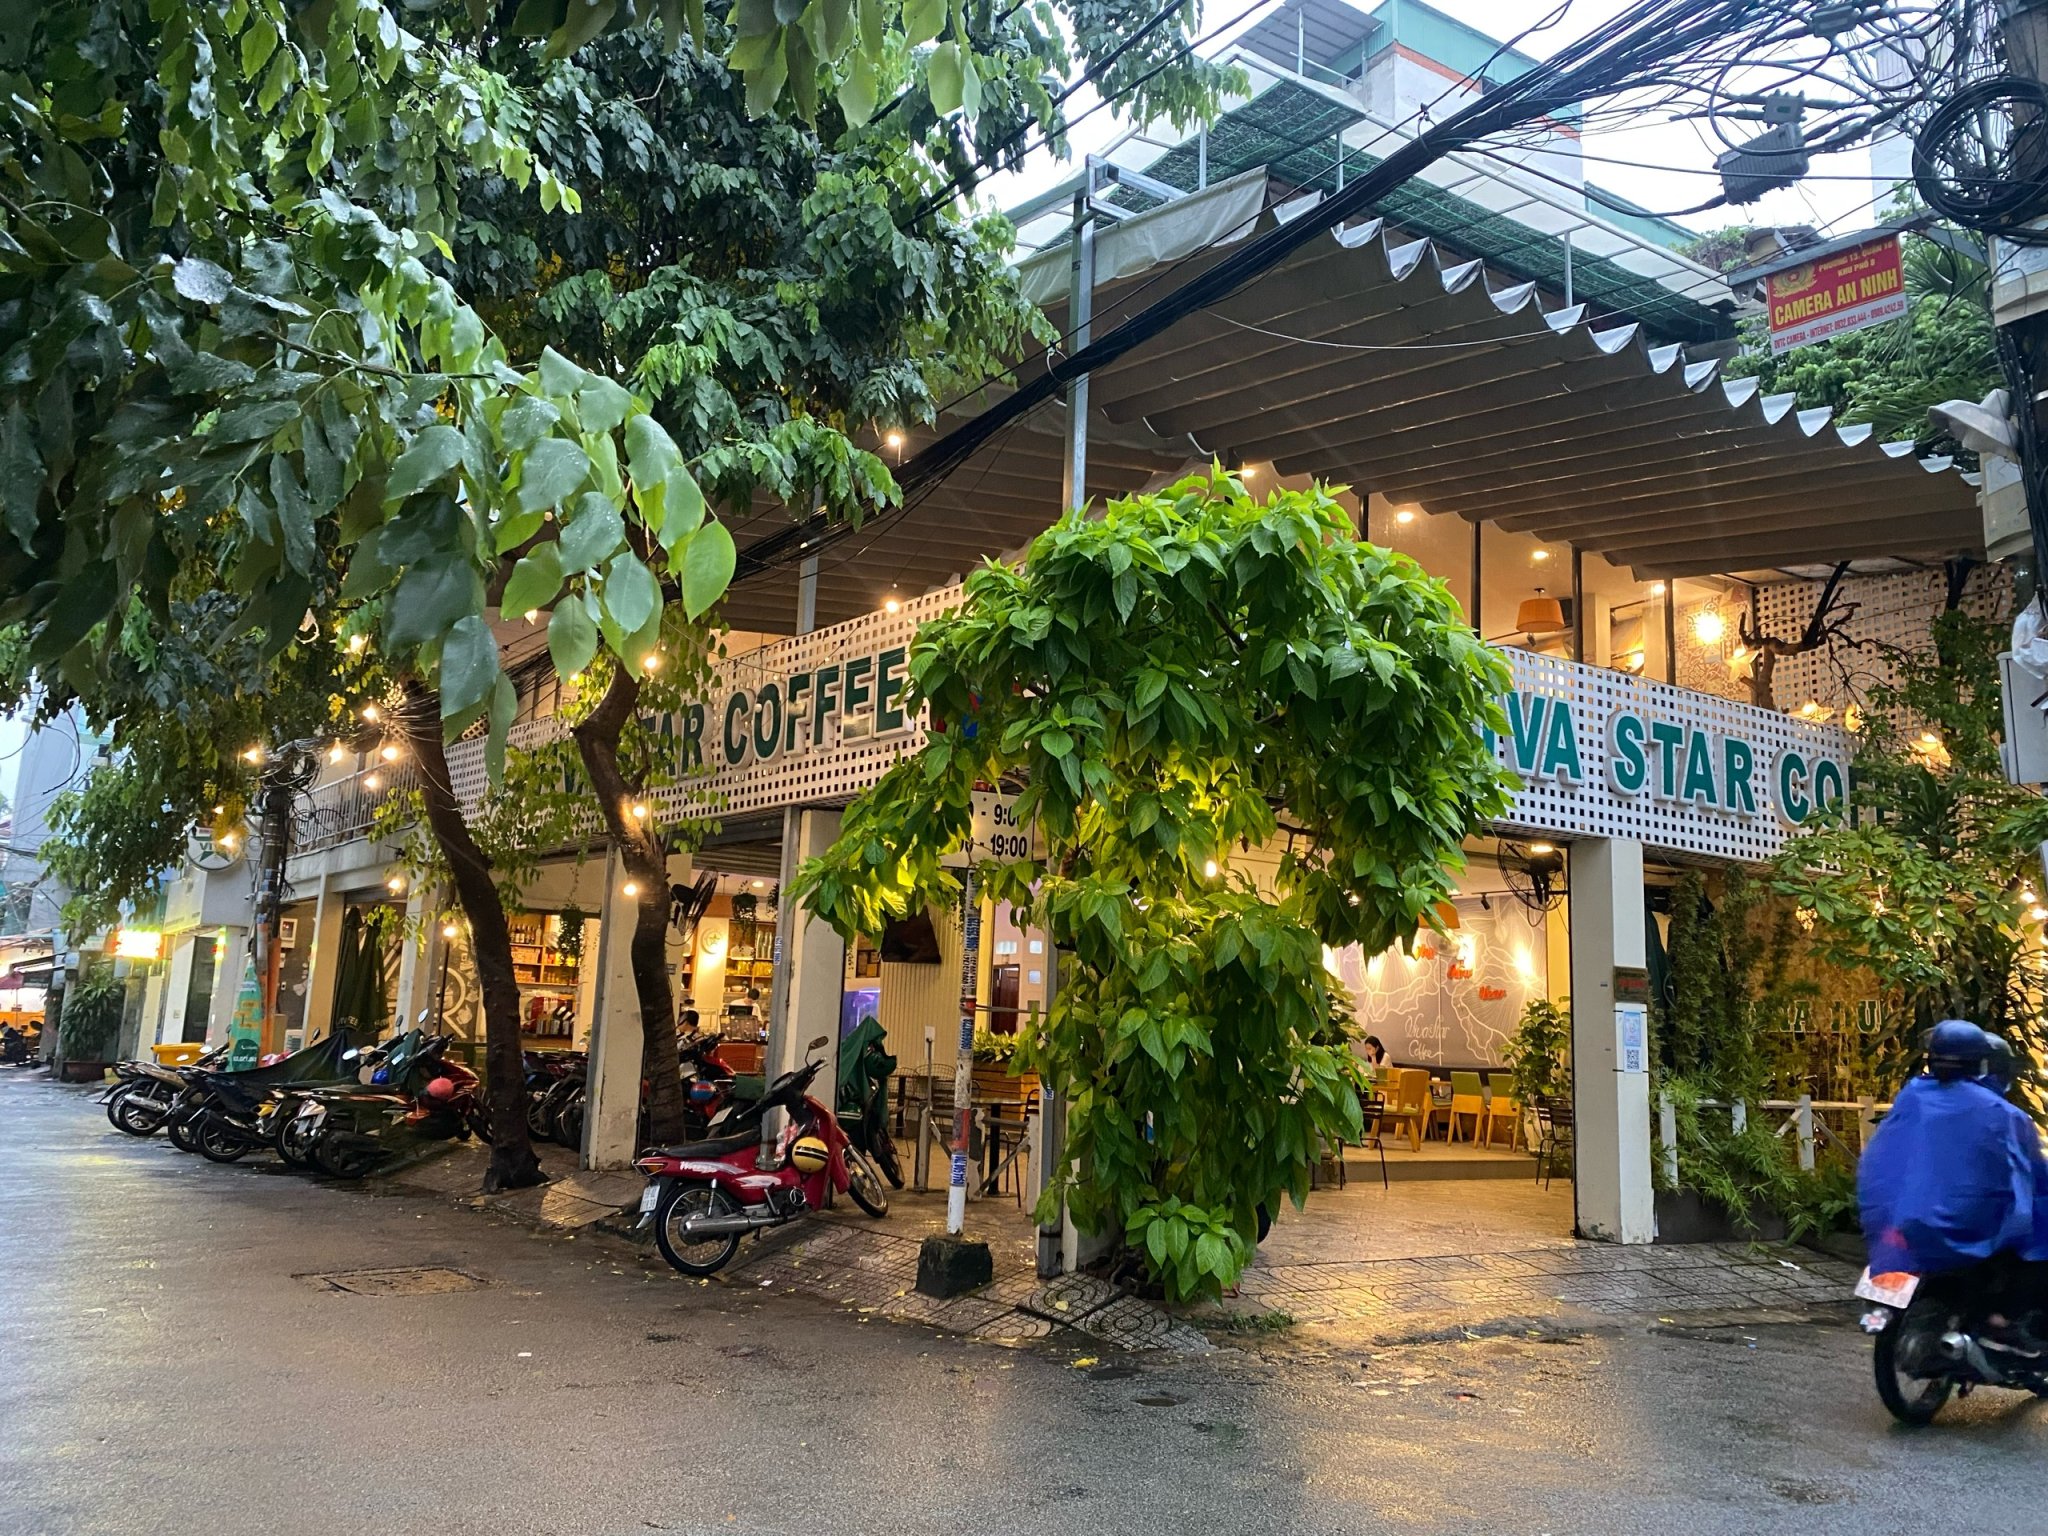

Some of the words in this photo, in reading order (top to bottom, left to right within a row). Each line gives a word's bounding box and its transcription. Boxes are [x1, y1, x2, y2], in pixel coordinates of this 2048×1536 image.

[1774, 290, 1833, 326] CAMERA
[1836, 280, 1857, 308] AN
[1860, 267, 1898, 299] NINH
[722, 646, 911, 768] COFFEE
[1611, 709, 1757, 818] STAR
[991, 834, 1027, 857] 19:00
